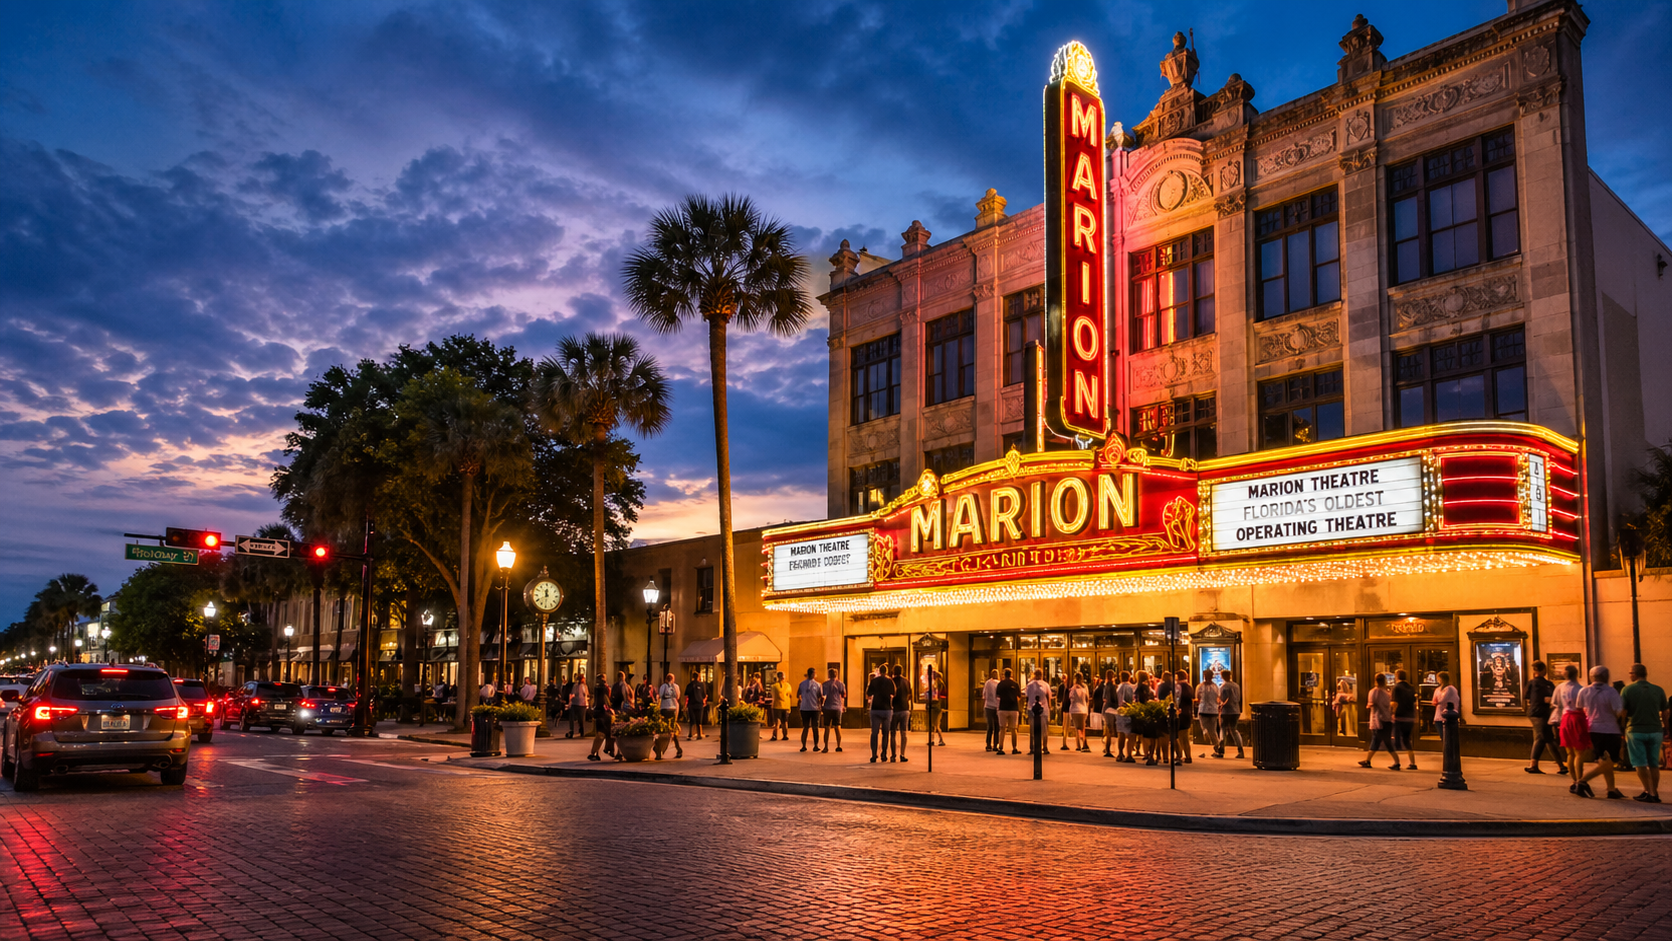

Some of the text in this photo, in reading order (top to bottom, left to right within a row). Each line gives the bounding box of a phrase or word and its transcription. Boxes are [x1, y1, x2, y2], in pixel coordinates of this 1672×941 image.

[1070, 92, 1099, 419] MARION
[1248, 469, 1379, 499] MARION THEATRE
[910, 472, 1137, 553] MARION
[1243, 490, 1384, 521] FLORIDA'S OLDEST
[1236, 511, 1397, 541] OPERATING THEATRE
[819, 539, 850, 553] THEATRE
